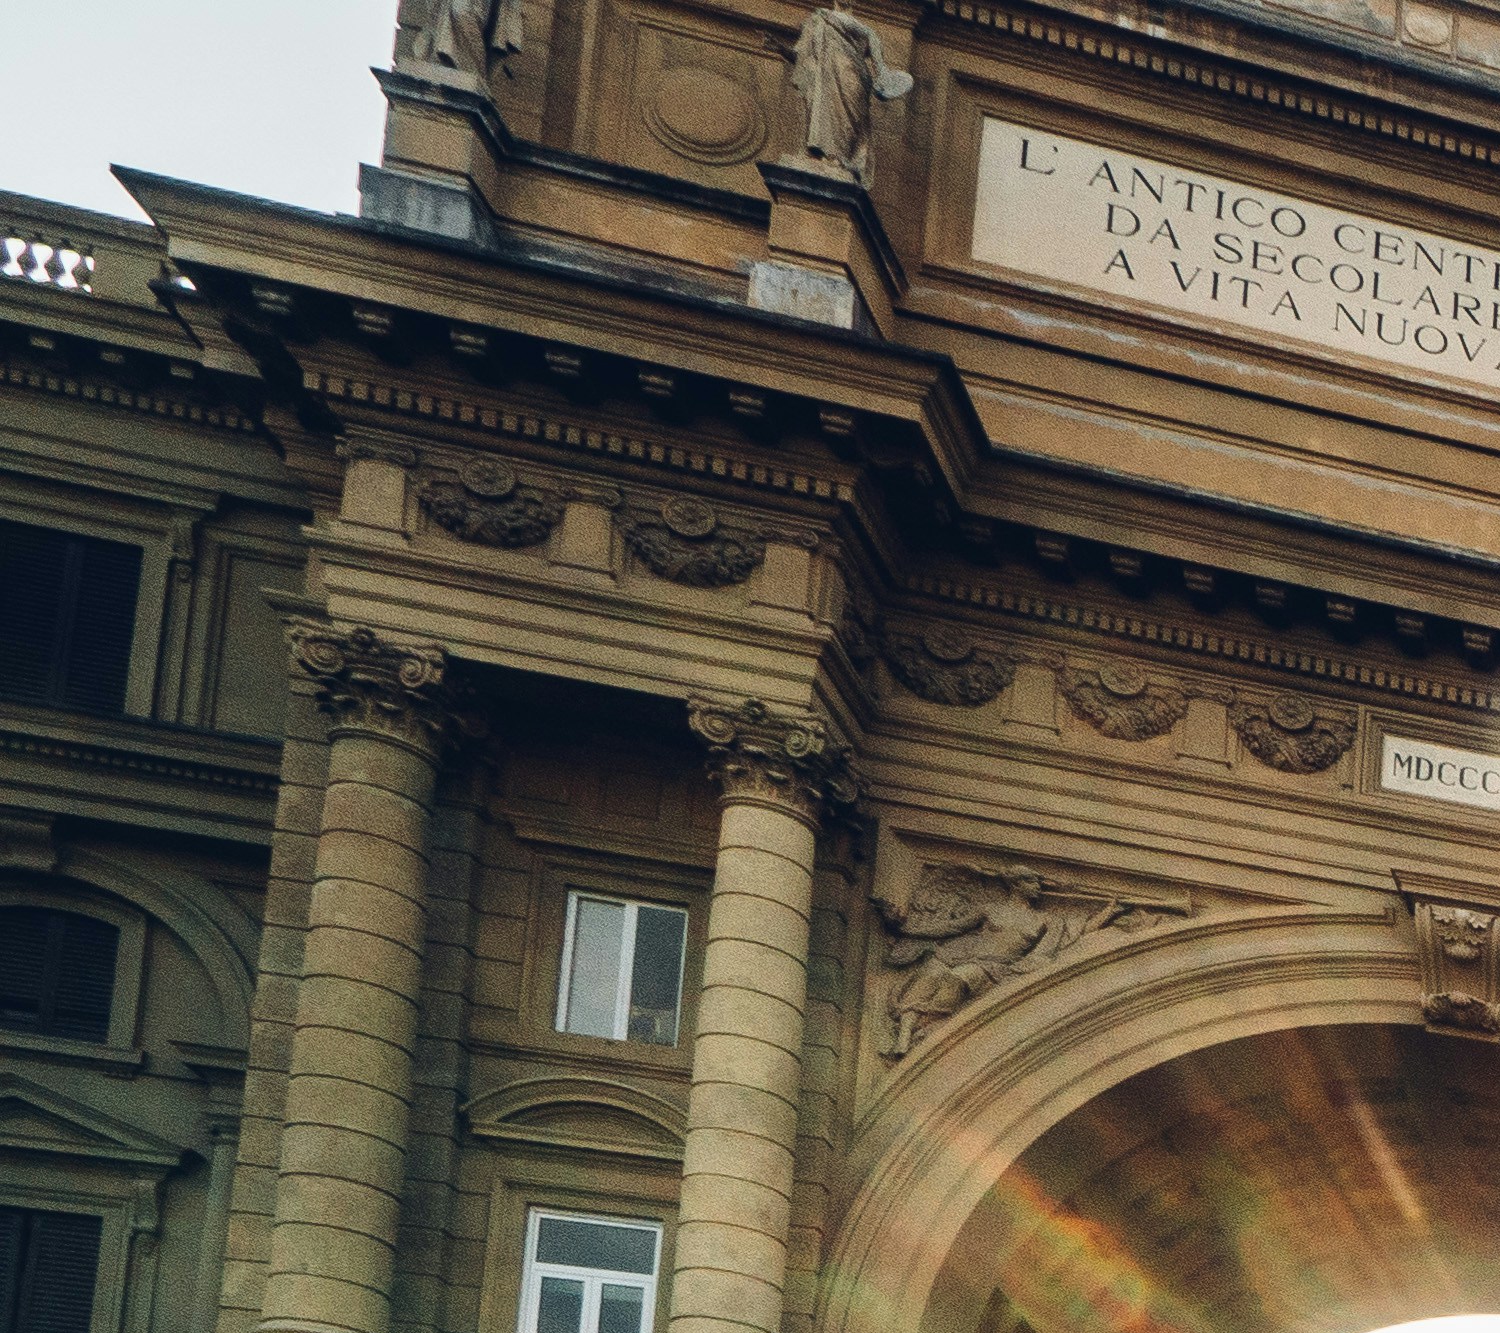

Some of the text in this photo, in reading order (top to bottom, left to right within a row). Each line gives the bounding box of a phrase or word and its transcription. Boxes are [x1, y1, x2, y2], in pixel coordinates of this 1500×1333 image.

[1019, 138, 1058, 175] L'
[1088, 160, 1307, 238] ANTICO
[1105, 203, 1182, 250] DA
[1103, 248, 1136, 281] A
[1169, 260, 1302, 321] VITA
